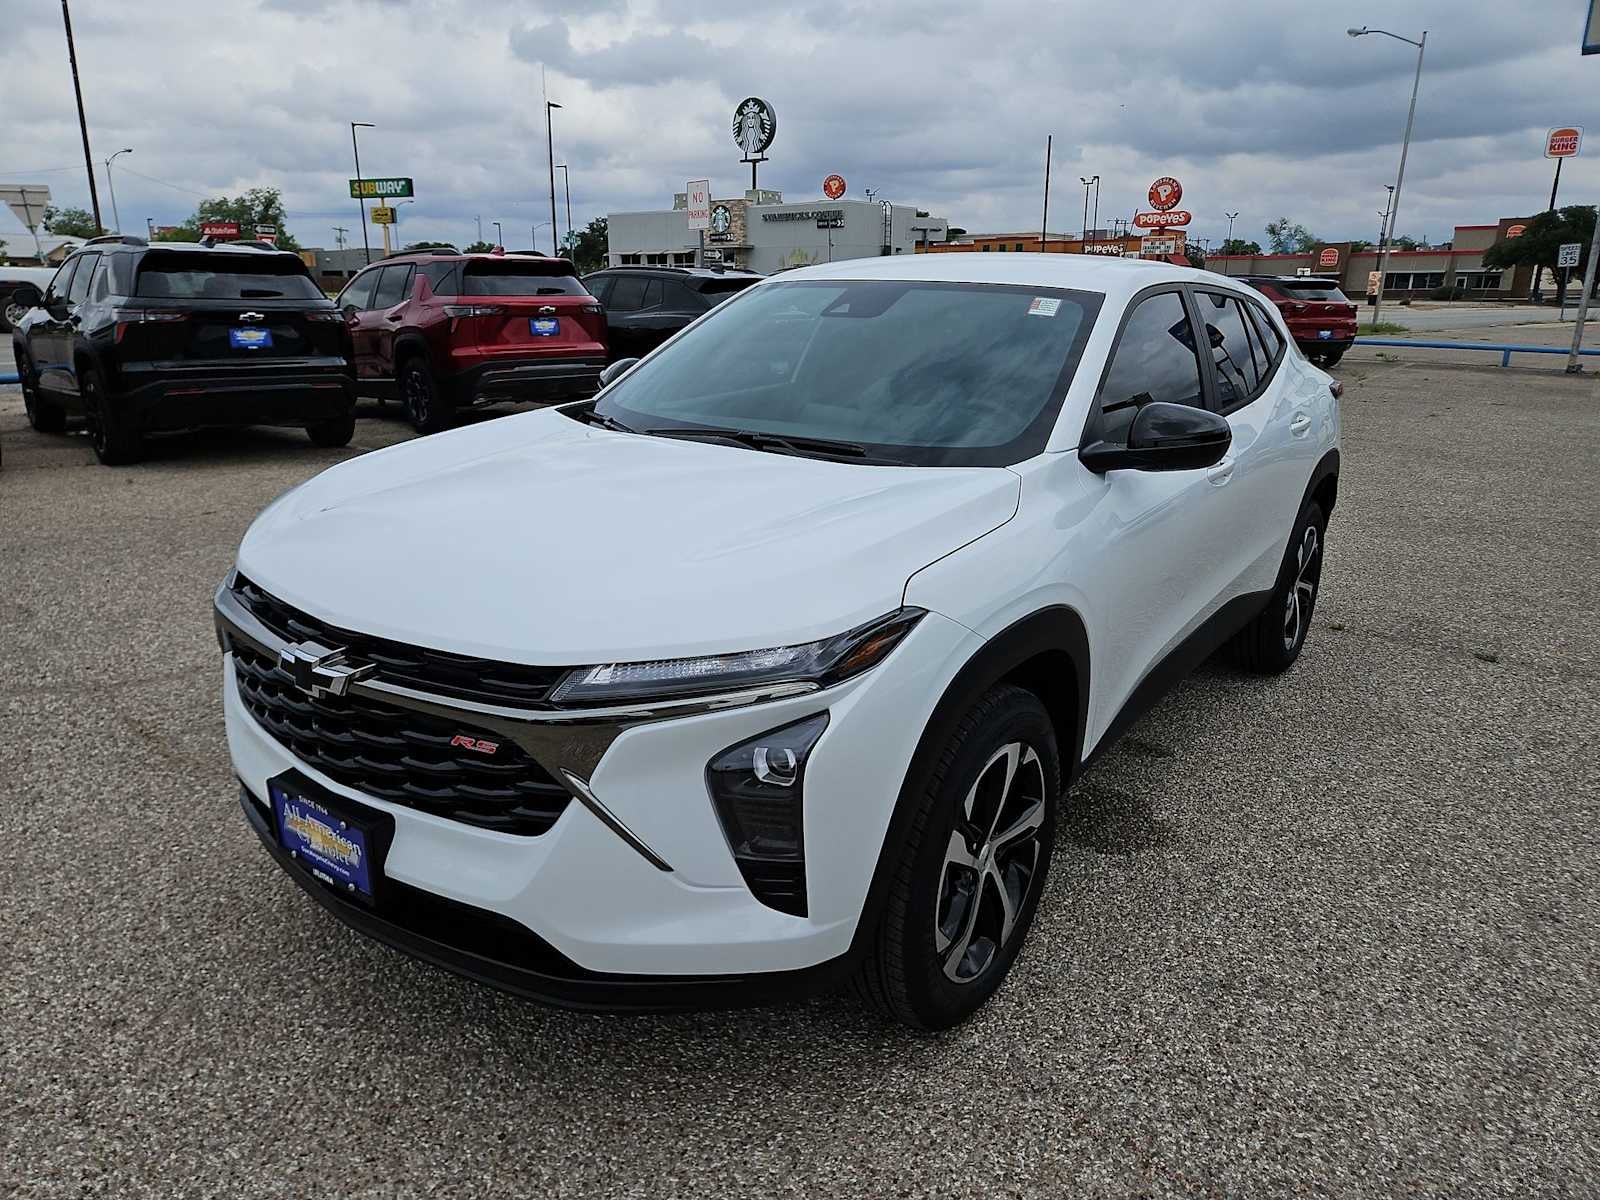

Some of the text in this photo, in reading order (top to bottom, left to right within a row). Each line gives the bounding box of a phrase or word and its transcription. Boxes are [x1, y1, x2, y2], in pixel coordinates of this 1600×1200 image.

[1549, 143, 1577, 151] KING
[352, 180, 406, 194] SUBWAY
[692, 191, 704, 203] NO
[688, 208, 708, 219] PARKING
[1560, 256, 1577, 265] 35
[450, 735, 500, 755] RS
[283, 802, 362, 856] All American
